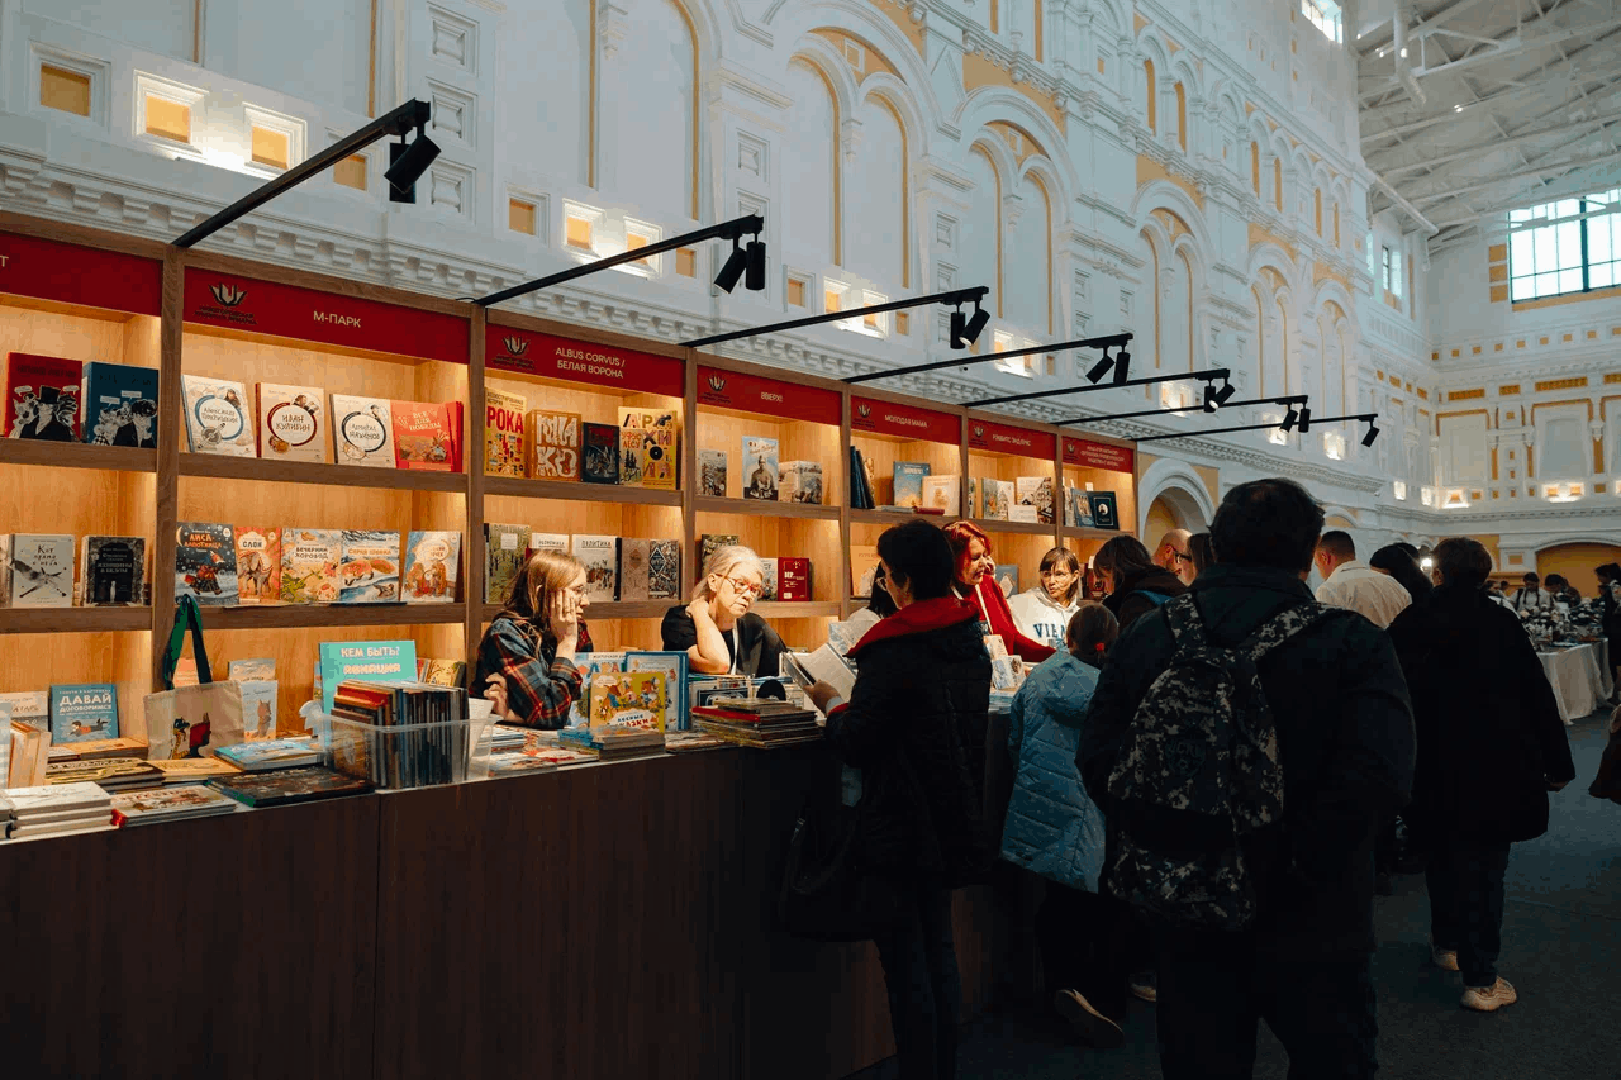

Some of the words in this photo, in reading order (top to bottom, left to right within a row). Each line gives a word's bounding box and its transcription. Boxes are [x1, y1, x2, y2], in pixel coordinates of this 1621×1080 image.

[313, 310, 361, 328] М-ПАРК
[555, 347, 585, 361] ALBUS
[585, 352, 620, 367] CORVUS
[556, 359, 587, 372] БЕЛАЯ
[588, 364, 623, 378] ВОРОНА
[487, 405, 524, 434] РОКА
[341, 647, 363, 658] КЕМ
[60, 693, 112, 706] ДАВАЙ
